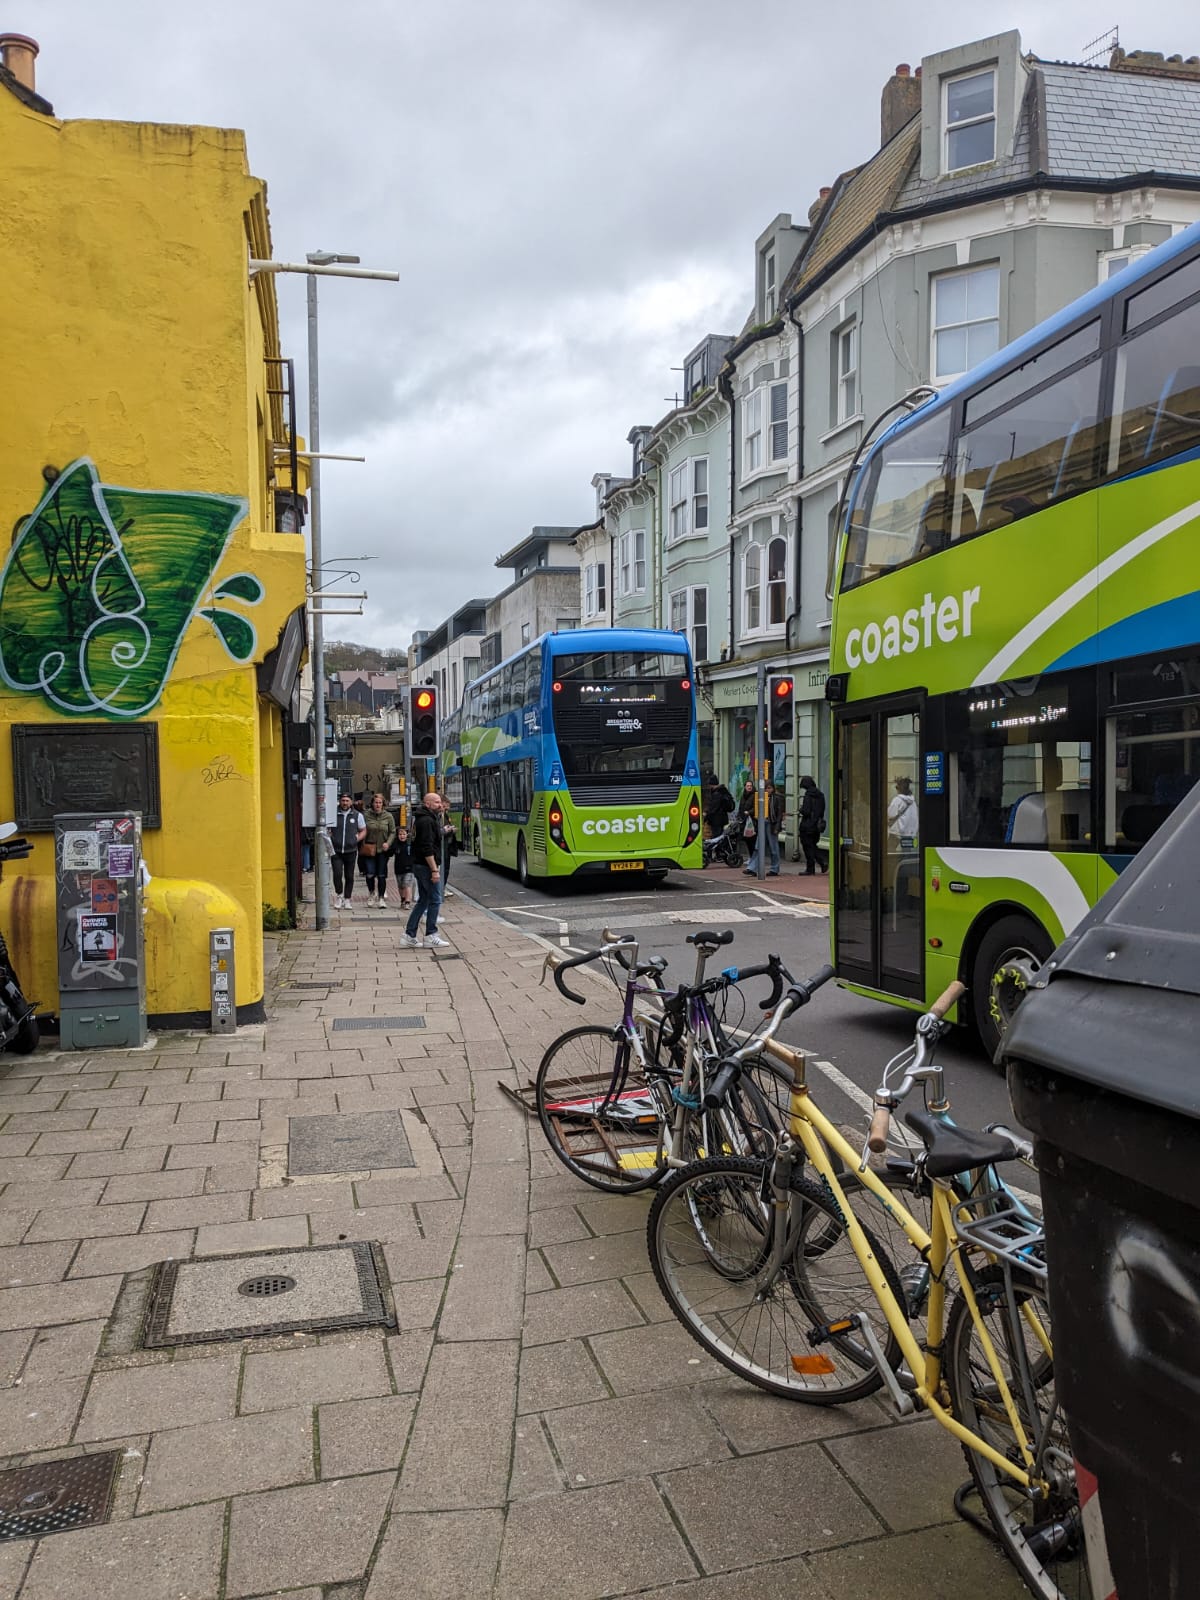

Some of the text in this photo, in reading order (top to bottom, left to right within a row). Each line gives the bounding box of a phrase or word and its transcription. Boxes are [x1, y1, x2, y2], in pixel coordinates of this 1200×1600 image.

[845, 585, 981, 669] coaster
[808, 670, 831, 688] Infin
[582, 814, 670, 835] coaster
